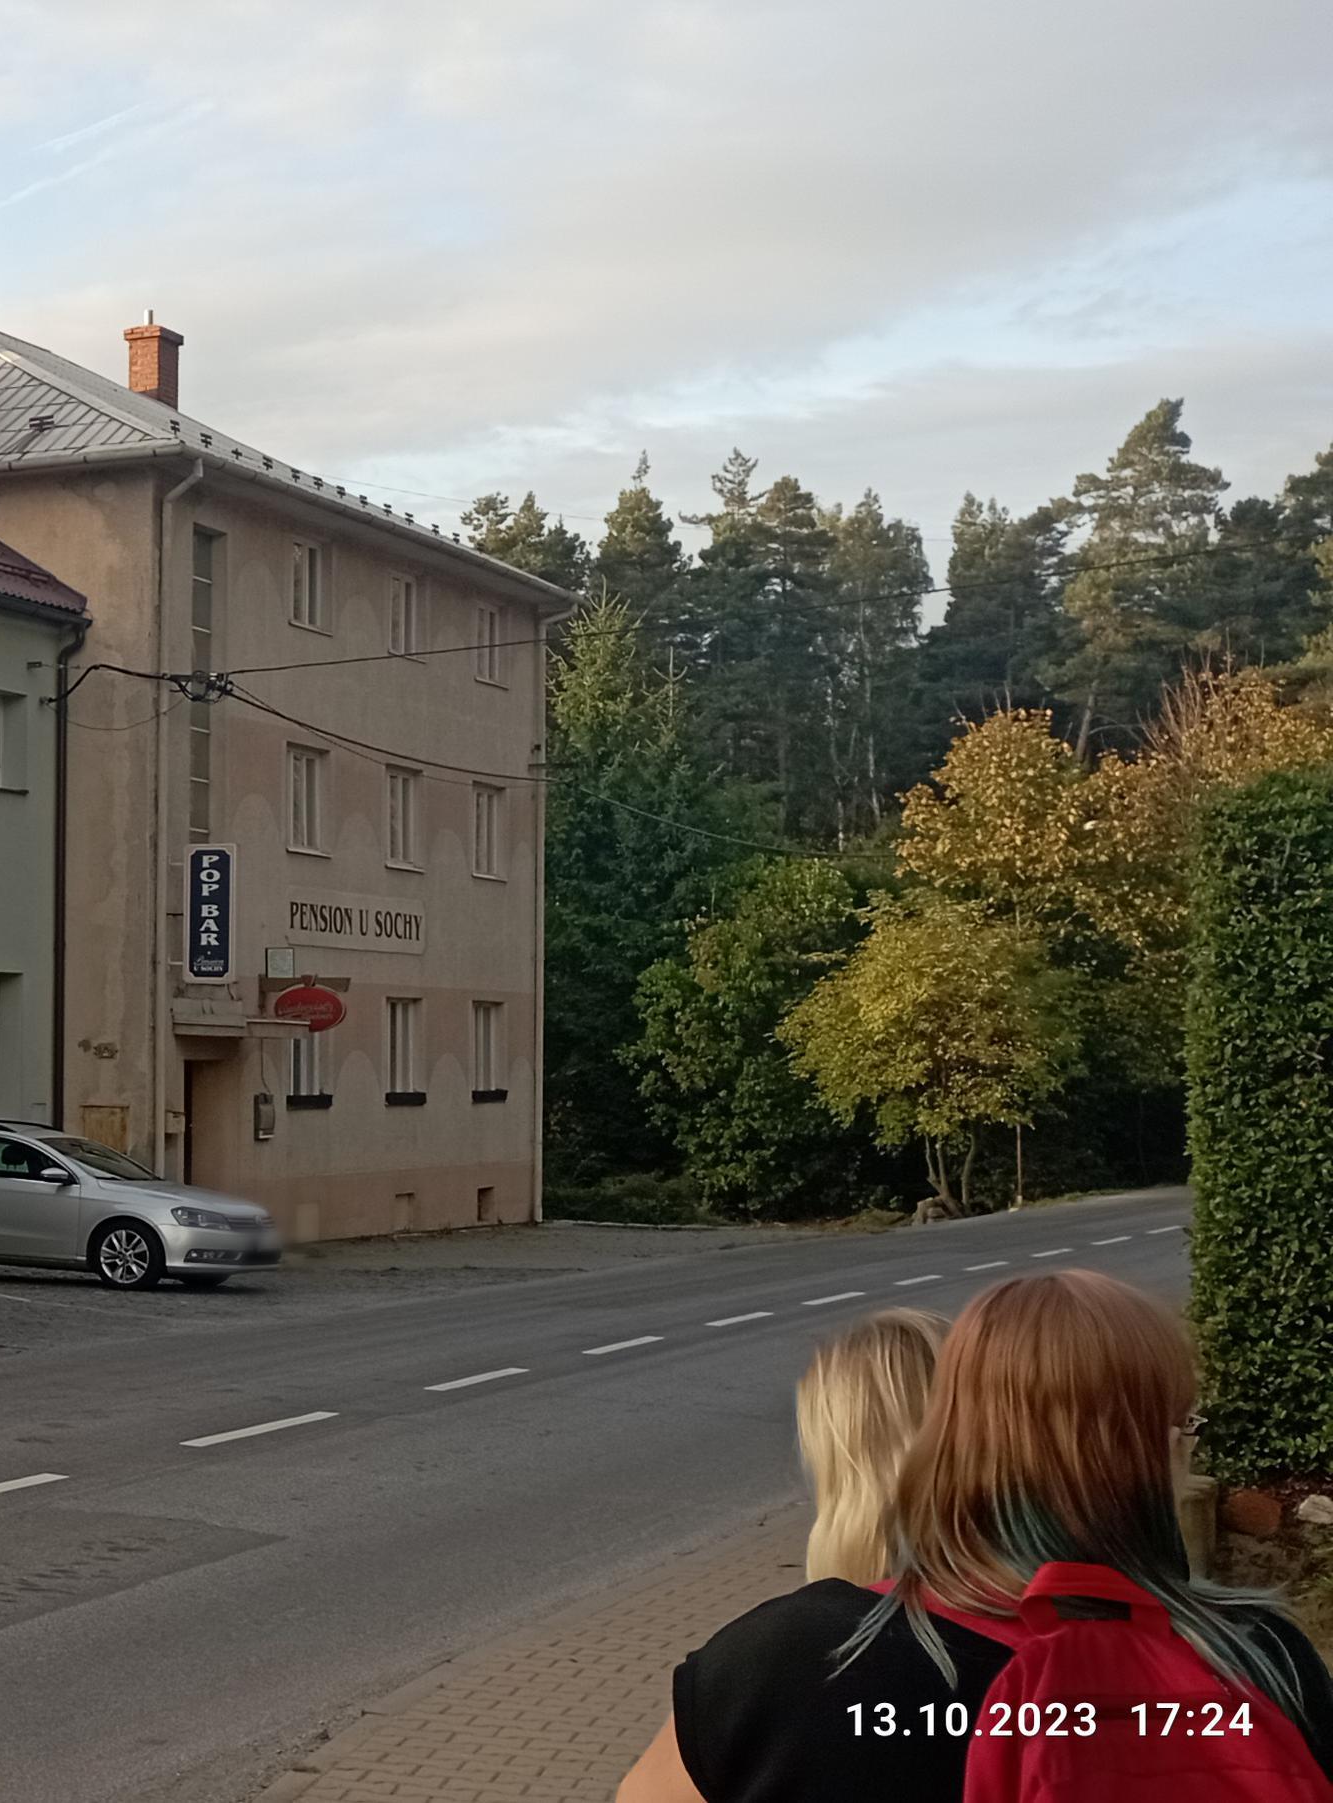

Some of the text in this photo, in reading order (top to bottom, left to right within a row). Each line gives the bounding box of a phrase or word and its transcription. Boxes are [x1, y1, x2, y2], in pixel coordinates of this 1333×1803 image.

[200, 854, 221, 897] POP
[199, 903, 220, 946] BAR
[289, 901, 423, 941] PENSION U SOCHY
